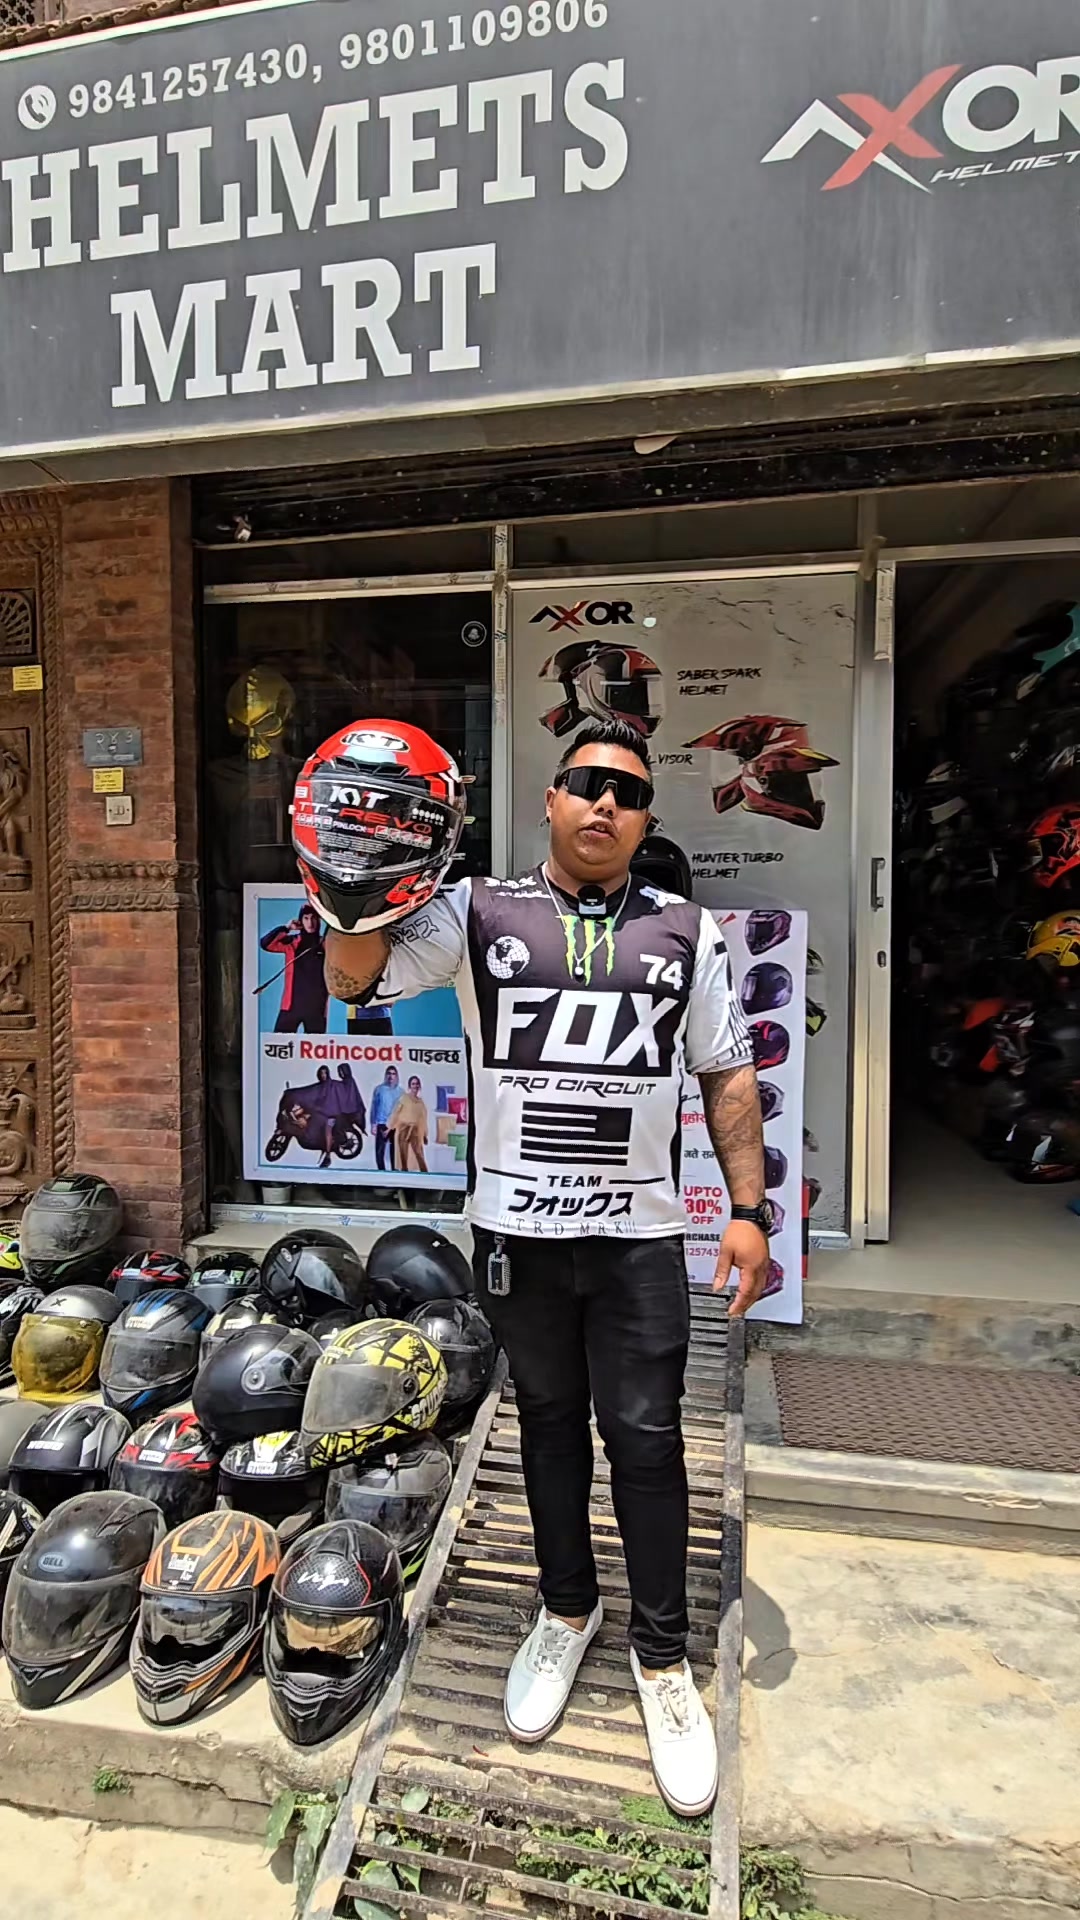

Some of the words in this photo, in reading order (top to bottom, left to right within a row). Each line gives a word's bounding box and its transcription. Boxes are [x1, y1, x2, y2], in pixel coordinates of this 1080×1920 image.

[68, 43, 323, 119] 9841257430,
[339, 0, 609, 70] 9801109806
[760, 55, 1080, 195] AXOR
[1, 57, 629, 273] HELMETS
[110, 242, 497, 408] MART
[528, 600, 635, 634] AXOR
[676, 669, 720, 681] SABER
[721, 667, 763, 680] SPARK
[679, 684, 729, 696] HELMET
[656, 753, 693, 766] VISOR
[329, 785, 390, 809] KYT
[691, 852, 740, 864] HUNTER
[740, 852, 785, 864] TURBO
[691, 867, 740, 879] HELMET
[639, 953, 684, 991] 74
[493, 987, 681, 1068] FOX
[299, 1039, 403, 1062] Raincoat
[408, 1048, 461, 1065] पाइन्छ
[498, 1075, 550, 1094] PRO
[555, 1078, 657, 1098] CIRCUIT
[547, 1174, 603, 1188] TEAM
[683, 1186, 723, 1198] UPTO
[507, 1188, 634, 1218] フォックス
[684, 1198, 722, 1215] 30%
[691, 1216, 715, 1225] OFF
[686, 1232, 721, 1242] RCHASE
[685, 1247, 720, 1257] 125743
[42, 1555, 65, 1567] BELL
